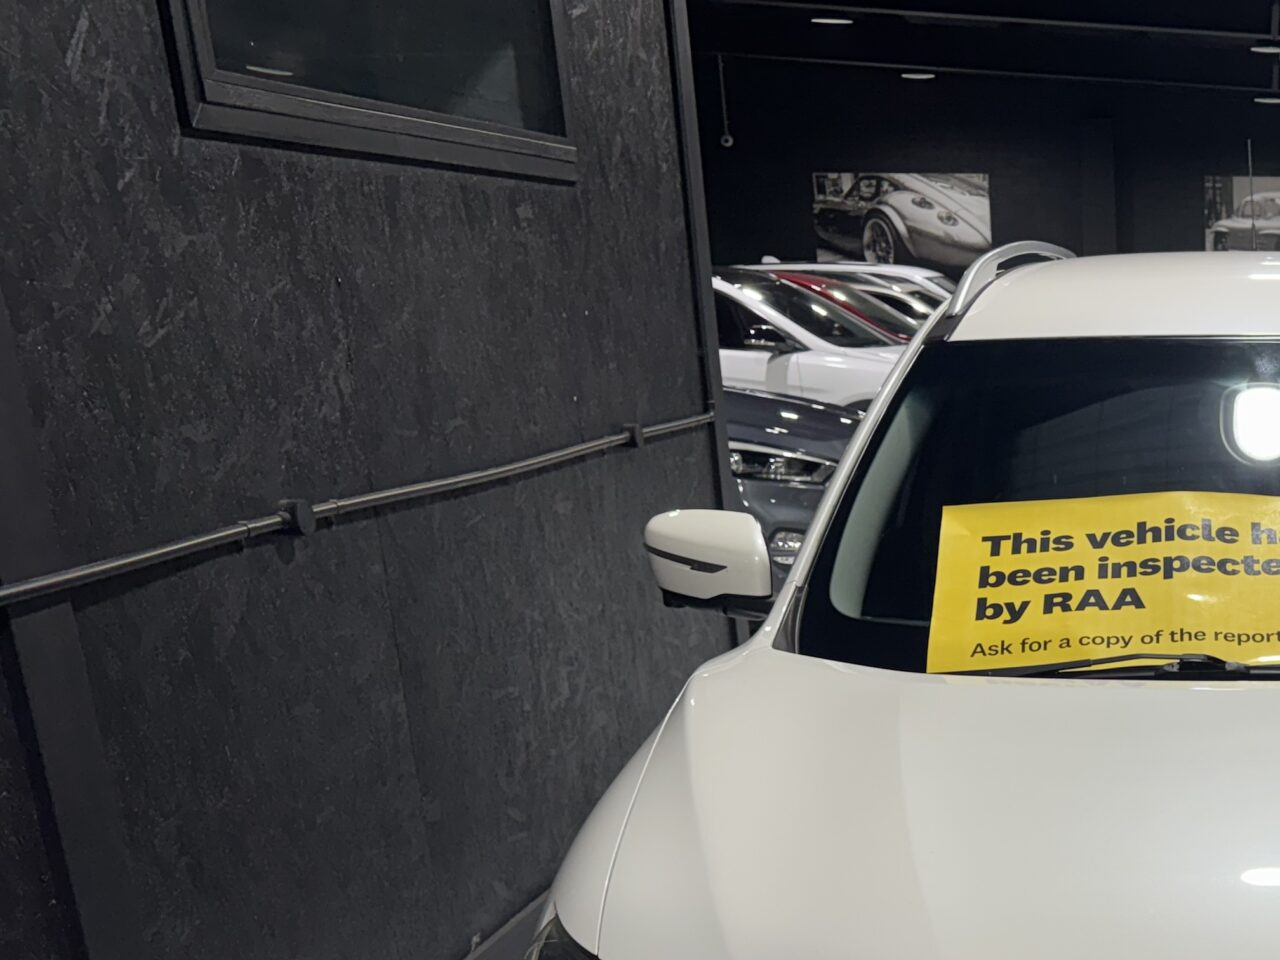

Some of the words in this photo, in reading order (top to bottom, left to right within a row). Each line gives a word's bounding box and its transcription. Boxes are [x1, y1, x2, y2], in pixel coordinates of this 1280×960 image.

[981, 530, 1074, 557] This
[1085, 517, 1239, 549] vehicle
[978, 565, 1085, 589] been
[975, 597, 1031, 624] by
[1042, 588, 1146, 615] RAA
[970, 640, 1013, 658] Ask
[1020, 638, 1052, 653] for
[1058, 637, 1072, 649] a
[1078, 634, 1133, 649] copy
[1140, 630, 1165, 645] of
[1169, 628, 1206, 642] the
